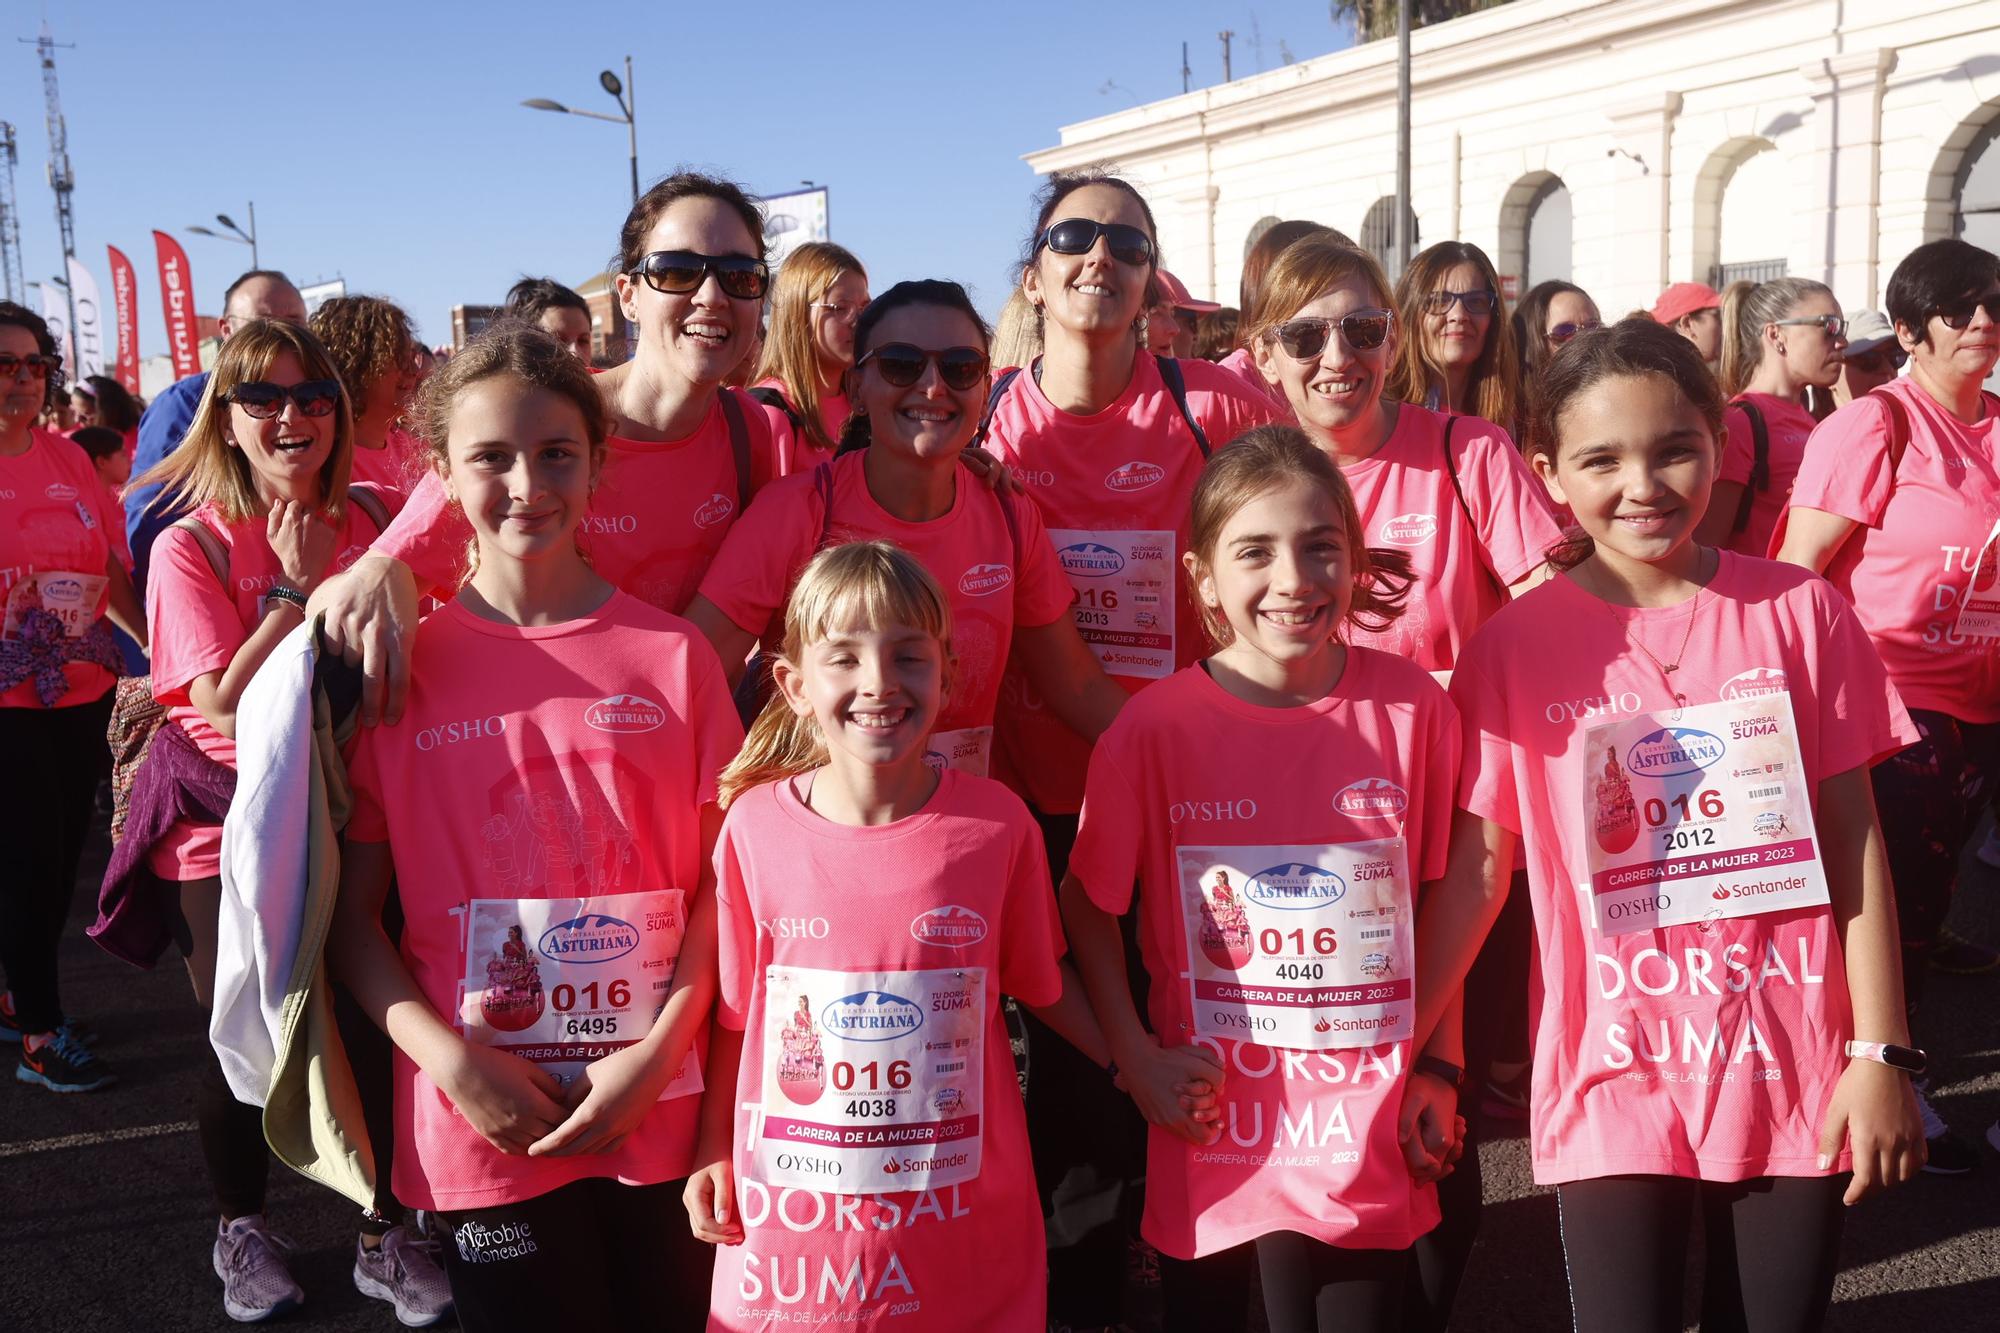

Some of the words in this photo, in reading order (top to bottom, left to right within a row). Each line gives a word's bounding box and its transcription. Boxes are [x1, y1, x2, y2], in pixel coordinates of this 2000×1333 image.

[1008, 464, 1054, 486] YSHO
[1110, 472, 1160, 486] ASTURIANA
[581, 515, 637, 534] YSHO
[1060, 554, 1119, 569] ASTURIANA
[1131, 551, 1162, 560] SUMA
[963, 573, 1009, 591] ASTURIANA
[1076, 611, 1108, 625] 2013
[1090, 632, 1102, 640] LA
[1104, 634, 1135, 643] MUJER
[1138, 637, 1159, 646] 2023
[1114, 653, 1163, 667] Santander
[592, 709, 658, 724] ASTURIANA
[1545, 692, 1641, 724] OYSHO
[1742, 715, 1777, 727] DORSAL
[415, 715, 506, 751] OYSHO
[1733, 723, 1778, 740] SUMA
[1634, 745, 1718, 769] ASTURIANA
[1169, 799, 1257, 824] OYSHO
[1644, 789, 1725, 827] 016
[1663, 828, 1715, 850] 2012
[1364, 860, 1394, 870] DORSAL
[1608, 865, 1665, 886] CARRERA
[1668, 863, 1687, 875] DE
[1690, 859, 1708, 872] LA
[1712, 852, 1758, 868] MUJER
[1765, 847, 1795, 862] 2023
[1354, 868, 1394, 882] SUMA
[1253, 880, 1338, 898] ASTURIANA
[1608, 894, 1671, 920] OYSHO
[1732, 877, 1807, 898] Santander
[646, 912, 653, 920] TU
[646, 918, 676, 932] SUMA
[918, 921, 981, 937] ASTURIANA
[546, 934, 633, 953] ASTURIANA
[1260, 927, 1337, 955] 016
[1276, 963, 1324, 980] 4040
[1594, 937, 1824, 1000] DORSAL
[552, 979, 631, 1011] 016
[932, 992, 940, 1000] TU
[942, 990, 972, 999] DORSAL
[1216, 987, 1273, 1002] CARRERA
[1277, 991, 1294, 1003] DE
[1298, 993, 1314, 1003] LA
[1317, 990, 1361, 1002] MUJER
[1367, 986, 1394, 1000] 2023
[932, 997, 971, 1012] SUMA
[566, 1017, 617, 1035] 6495
[828, 1009, 916, 1028] ASTURIANA
[1214, 1012, 1277, 1032] OYSHO
[1333, 1014, 1400, 1032] Santander
[1602, 1016, 1775, 1069] SUMA
[512, 1048, 561, 1060] RRERA
[566, 1047, 584, 1056] DE
[588, 1047, 604, 1057] LA
[832, 1060, 912, 1090] 016
[1662, 1070, 1677, 1082] DE
[1680, 1073, 1695, 1083] LA
[1752, 1069, 1782, 1083] 2023
[845, 1099, 896, 1117] 4038
[786, 1124, 841, 1143] CARRERA
[845, 1132, 863, 1143] DE
[867, 1130, 884, 1142] LA
[888, 1128, 934, 1141] MUJER
[939, 1123, 965, 1138] 2023
[1205, 1101, 1353, 1149] UMA
[777, 1153, 842, 1177] OYSHO
[903, 1153, 968, 1173] Santander
[1193, 1152, 1246, 1165] CARRERA
[1250, 1154, 1265, 1166] DE
[1268, 1155, 1283, 1167] LA
[1285, 1155, 1320, 1167] MUJER
[1332, 1151, 1359, 1164] 2023
[741, 1177, 970, 1233] DORSAL
[456, 1221, 532, 1248] Aerobic
[470, 1238, 538, 1263] Moncada
[739, 1251, 915, 1304] SUMA
[736, 1306, 789, 1323] CARRERA
[793, 1311, 809, 1323] DE
[813, 1312, 828, 1323] LA
[890, 1301, 920, 1317] 2023
